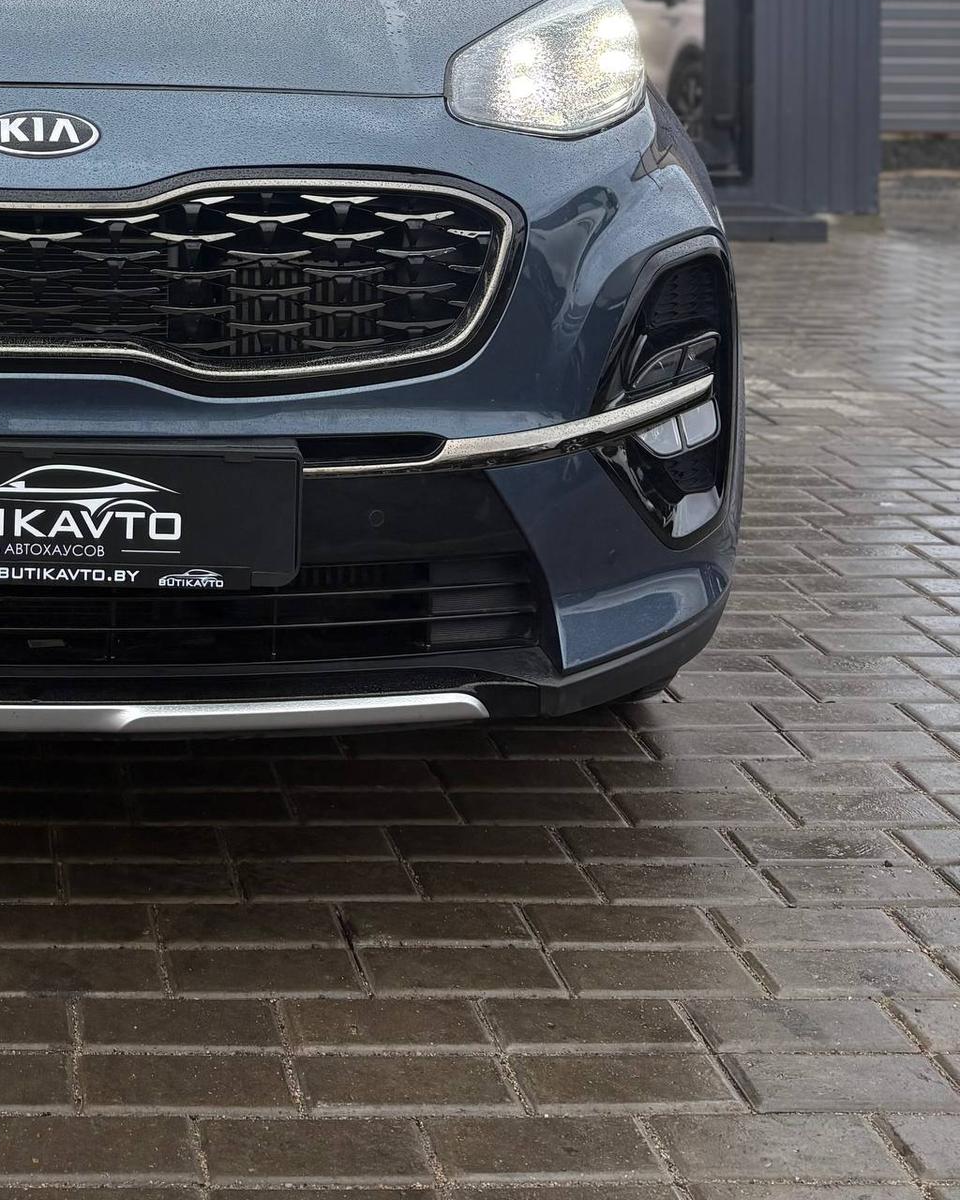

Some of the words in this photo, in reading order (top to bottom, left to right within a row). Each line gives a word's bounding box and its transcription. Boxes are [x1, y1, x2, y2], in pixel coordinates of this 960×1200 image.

[0, 117, 80, 143] KIA
[4, 542, 105, 558] АВТОХАУСОВ
[158, 578, 224, 588] BUTIKAVTO
